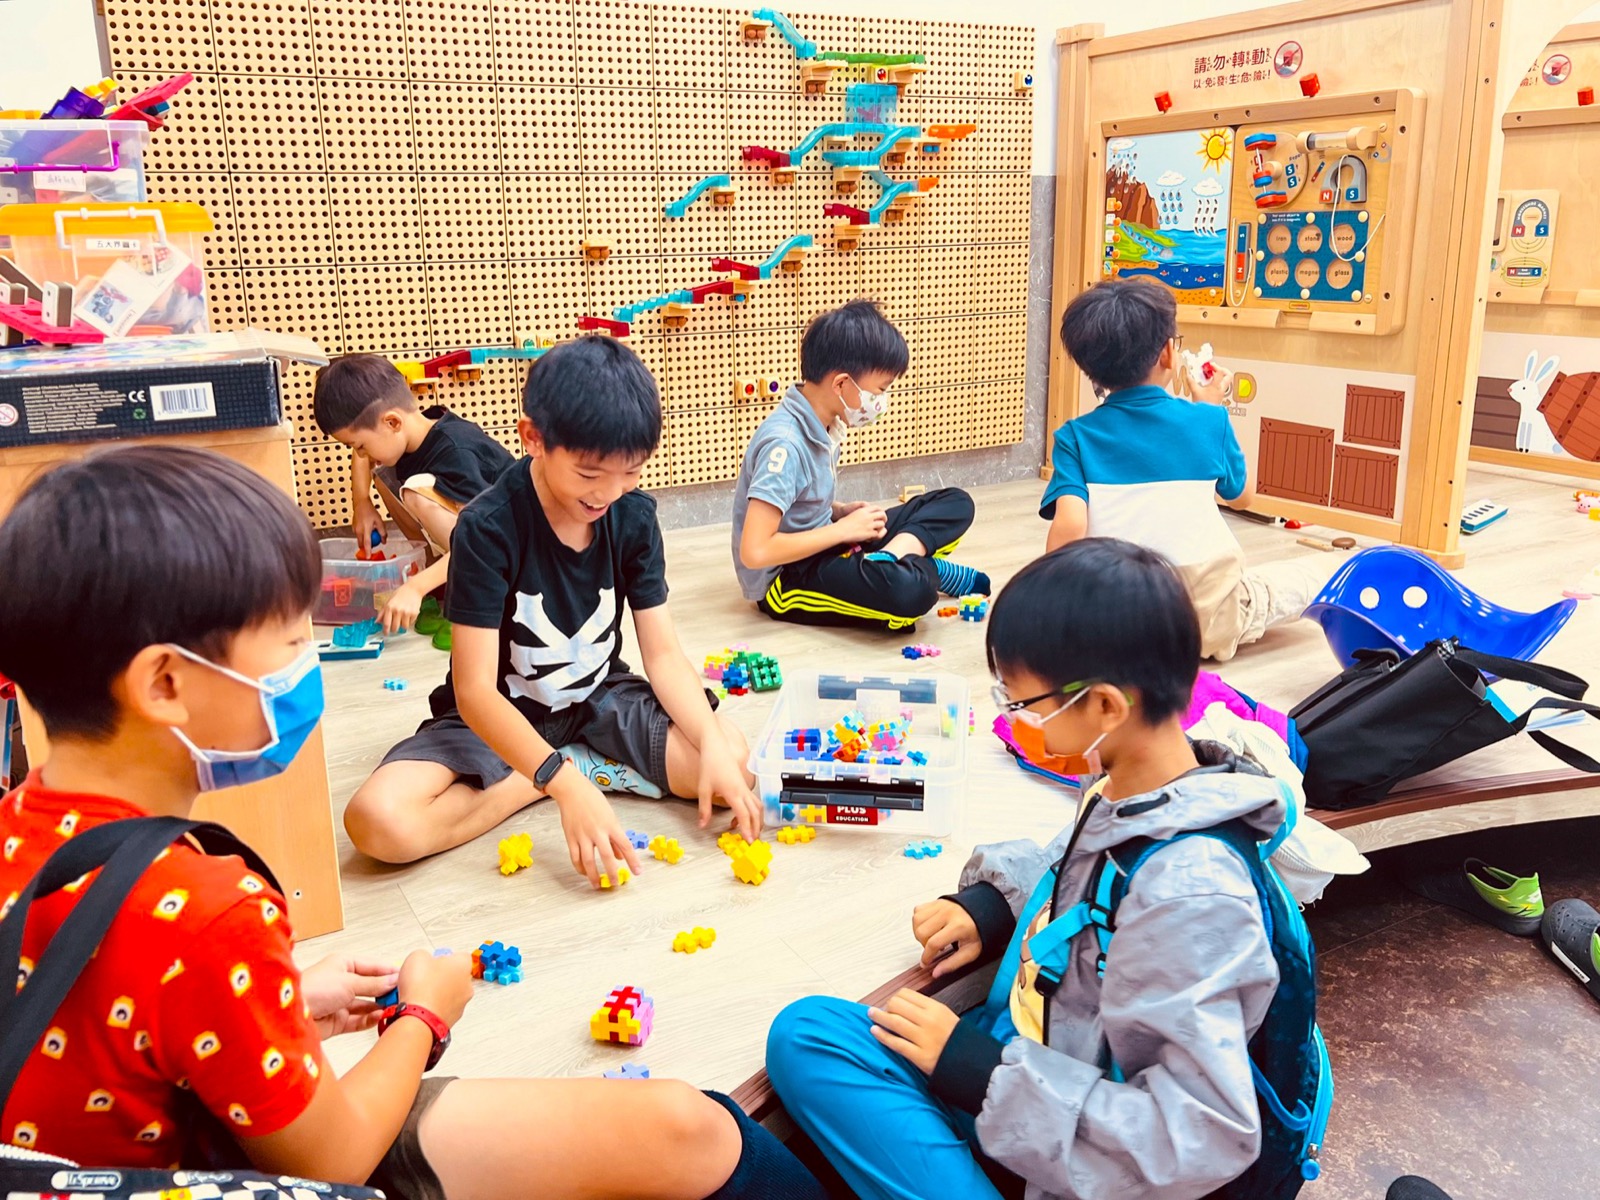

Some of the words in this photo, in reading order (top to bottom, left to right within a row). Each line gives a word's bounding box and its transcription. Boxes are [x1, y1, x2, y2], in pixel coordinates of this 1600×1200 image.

[1322, 191, 1330, 201] N
[1349, 190, 1355, 199] S
[1334, 269, 1350, 277] glass
[128, 390, 147, 403] CE
[767, 446, 788, 473] 9
[837, 806, 866, 815] PLUS
